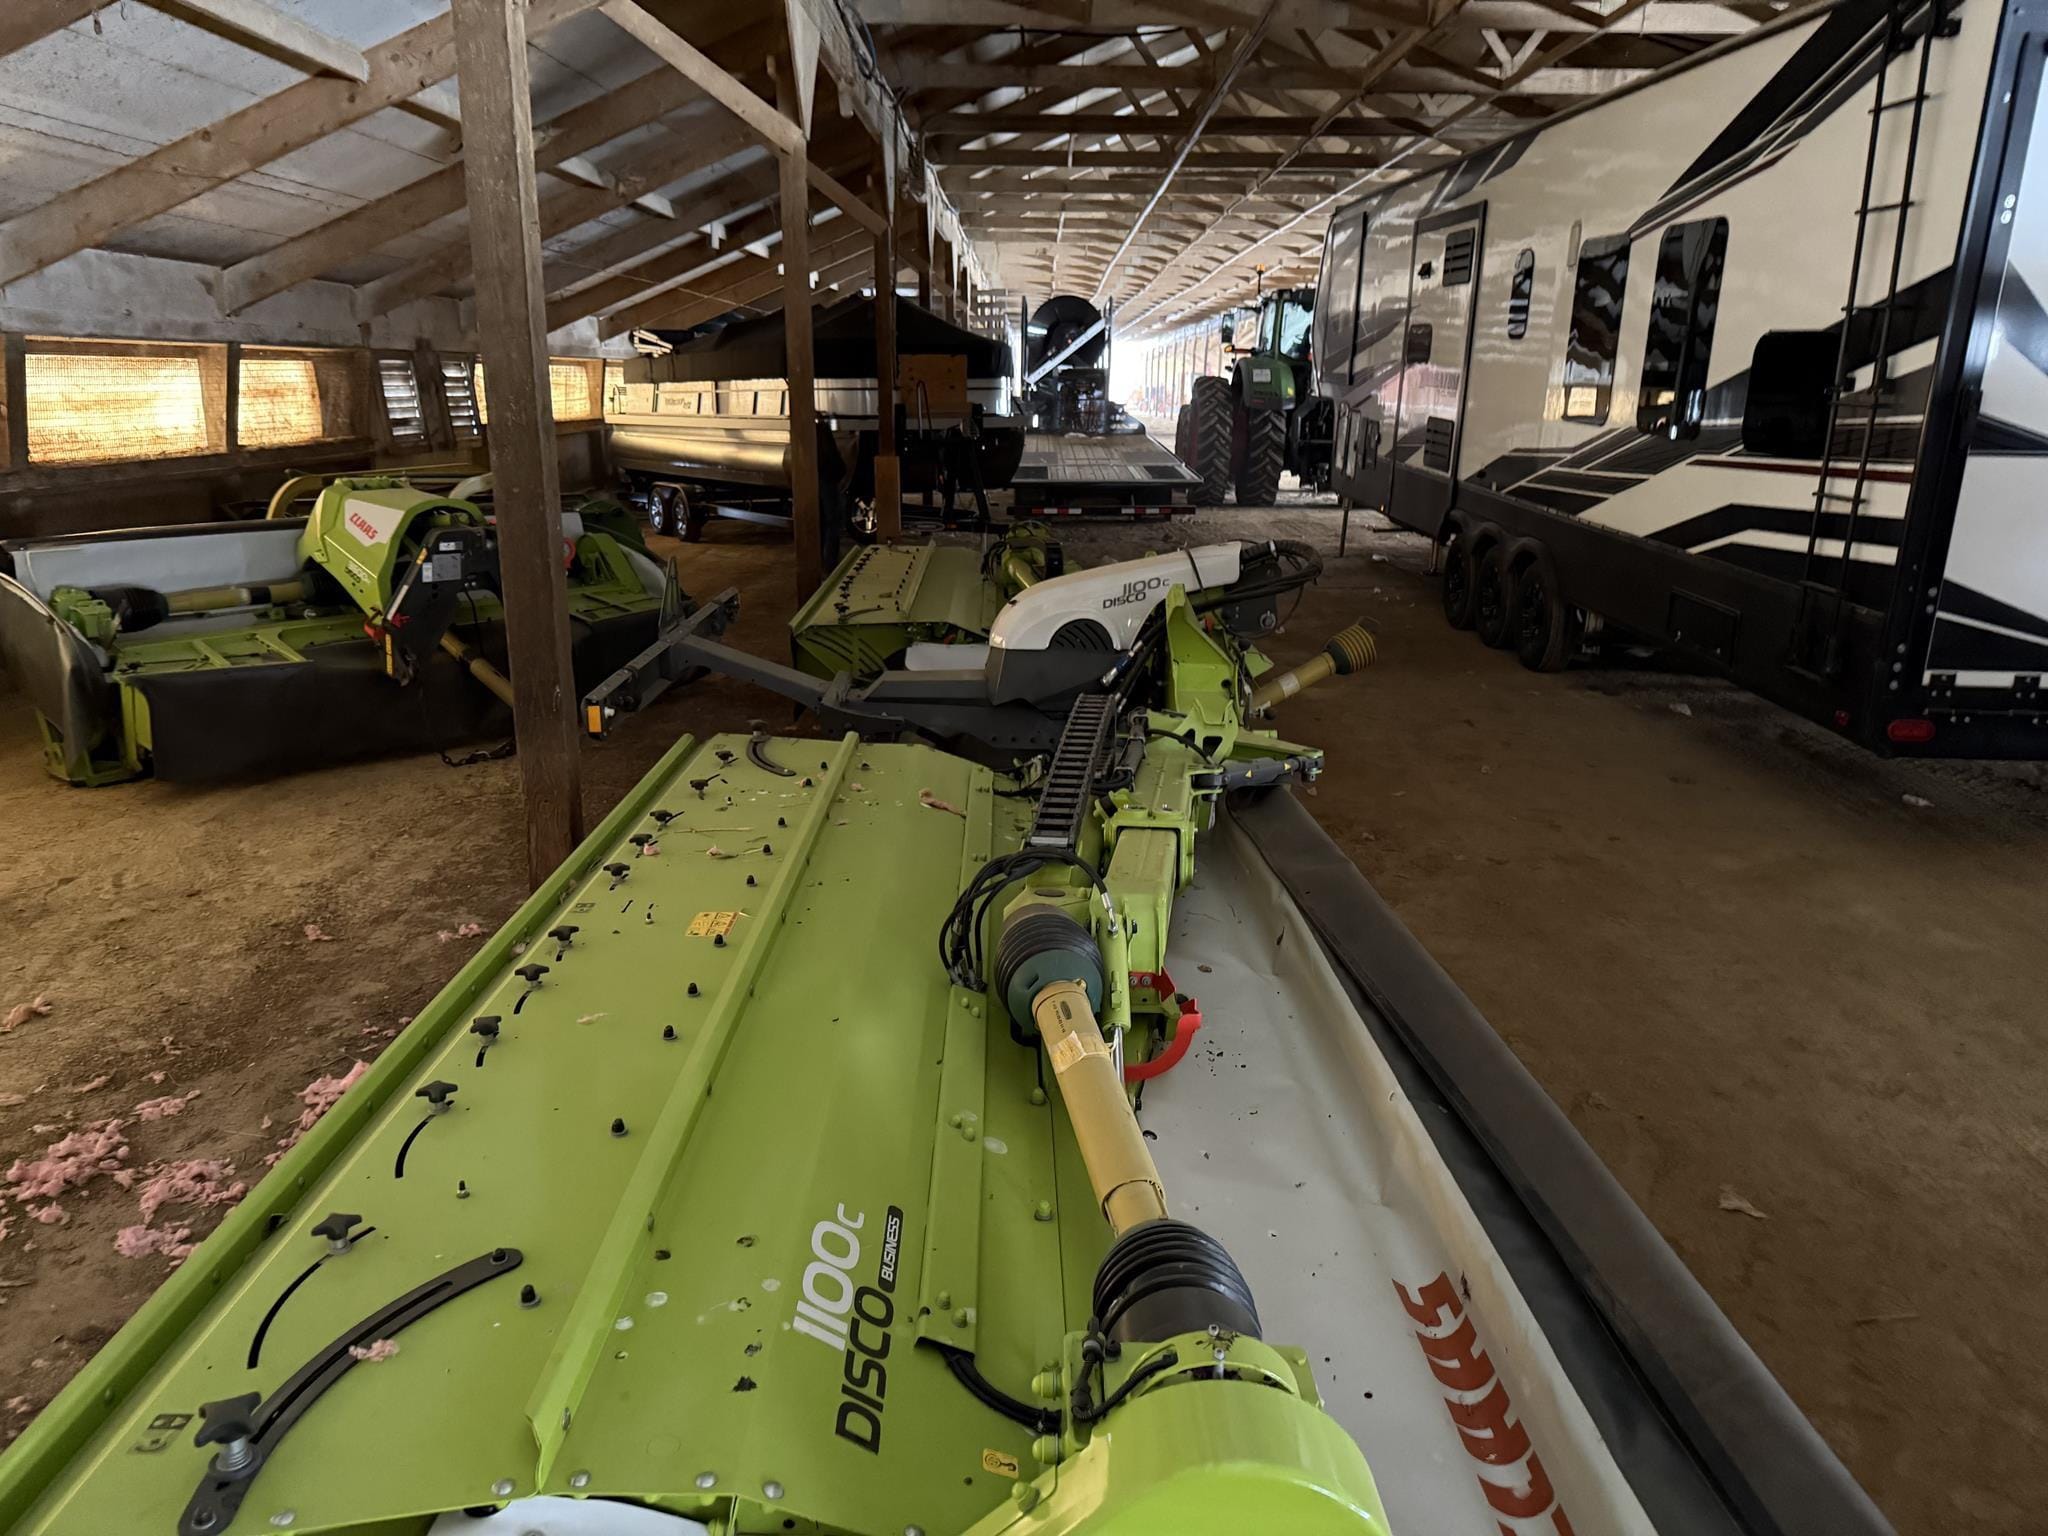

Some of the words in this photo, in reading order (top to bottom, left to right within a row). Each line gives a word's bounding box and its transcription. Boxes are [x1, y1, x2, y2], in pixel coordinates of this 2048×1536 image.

[349, 513, 378, 540] CLAAS
[1103, 591, 1146, 609] DISCO
[835, 1286, 894, 1456] DISCO
[881, 1214, 900, 1282] BUSINESS
